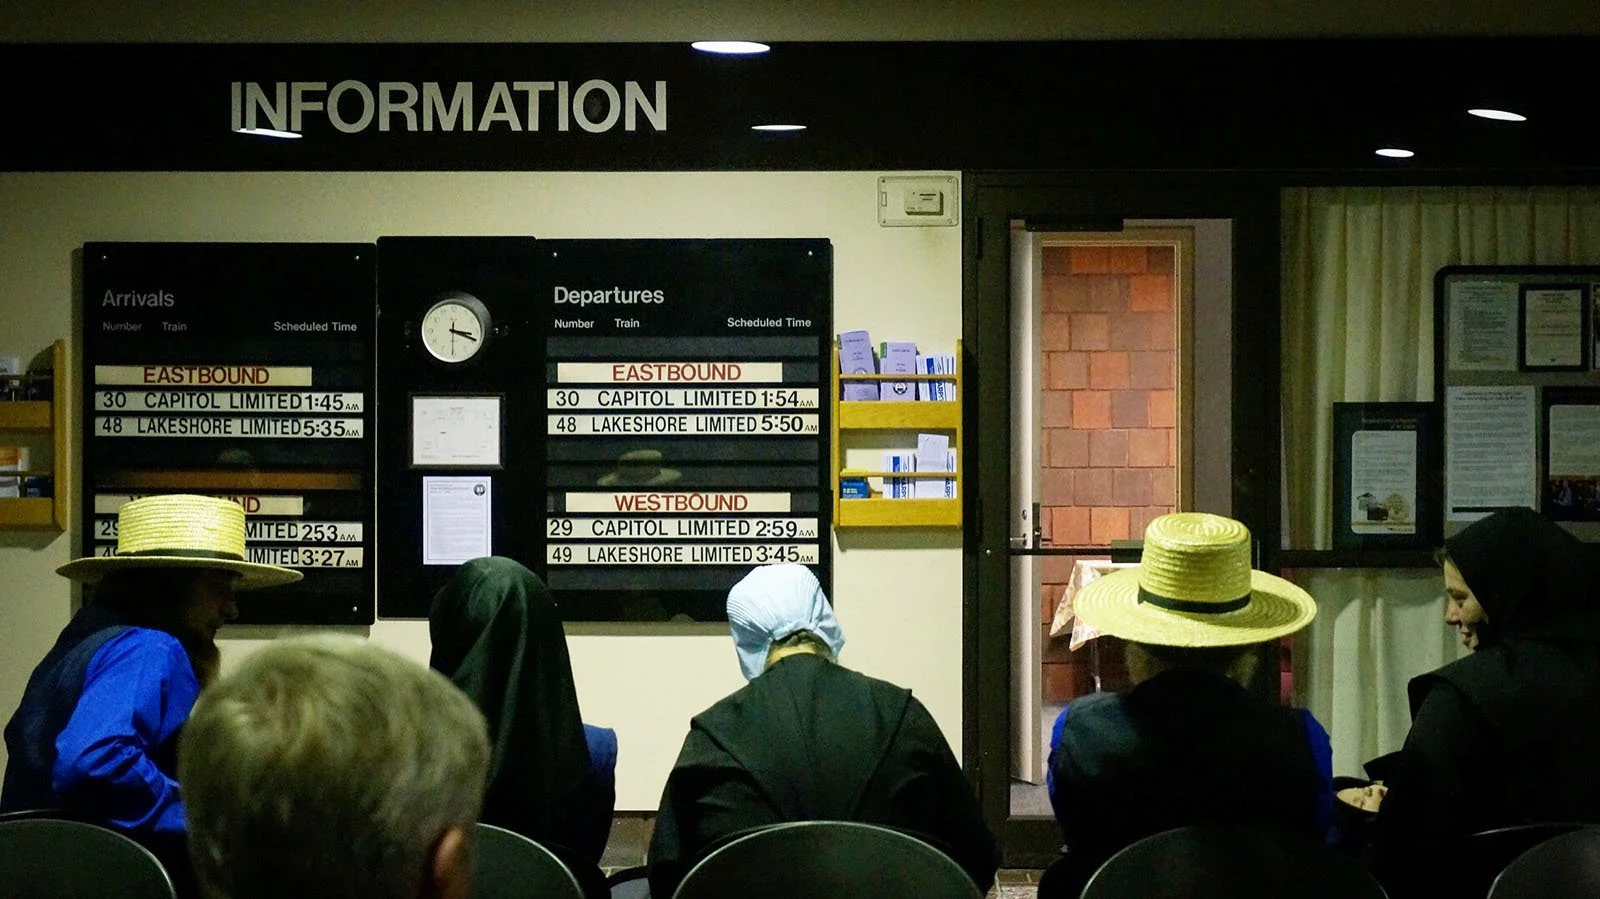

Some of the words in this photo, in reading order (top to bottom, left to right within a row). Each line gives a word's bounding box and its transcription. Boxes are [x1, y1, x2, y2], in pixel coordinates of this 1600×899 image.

[231, 79, 668, 134] INFORMATION
[102, 289, 175, 308] Arrivals
[554, 286, 665, 307] Departures
[102, 321, 142, 333] Number
[161, 321, 188, 333] Train
[273, 320, 329, 333] Scheduled
[331, 320, 358, 333] Time
[554, 318, 595, 329] Number
[614, 318, 640, 329] Train
[727, 317, 783, 329] Scheduled
[785, 317, 812, 329] Time
[143, 366, 270, 385] EASTBOUND
[612, 363, 742, 382] EASTBOUND
[103, 392, 127, 408] 30
[144, 391, 221, 409] CAPITOL
[229, 393, 301, 410] LIMITED
[304, 393, 344, 411] 1:45
[555, 391, 580, 407] 30
[597, 390, 675, 407] CAPITOL
[684, 390, 757, 407] LIMITED
[761, 390, 799, 407] 1:54
[102, 417, 123, 434] 48
[137, 417, 232, 435] LAKESHORE
[240, 418, 301, 436] LIMITED
[303, 420, 346, 437] 5:35
[556, 416, 577, 432] 48
[592, 416, 688, 432] LAKESHORE
[696, 416, 757, 432] LIMITED
[761, 415, 804, 432] 5:50
[614, 493, 748, 511] WESTBOUND
[246, 522, 299, 539] MITED
[549, 519, 573, 536] 29
[591, 519, 669, 536] CAPITOL
[677, 519, 751, 536] LIMITED
[755, 520, 798, 537] 2:59
[249, 548, 300, 565] IMITED
[302, 549, 345, 566] 3:27
[552, 546, 572, 562] 49
[587, 546, 683, 562] LAKESHORE
[691, 546, 753, 562] LIMITED
[756, 545, 800, 562] 3:45
